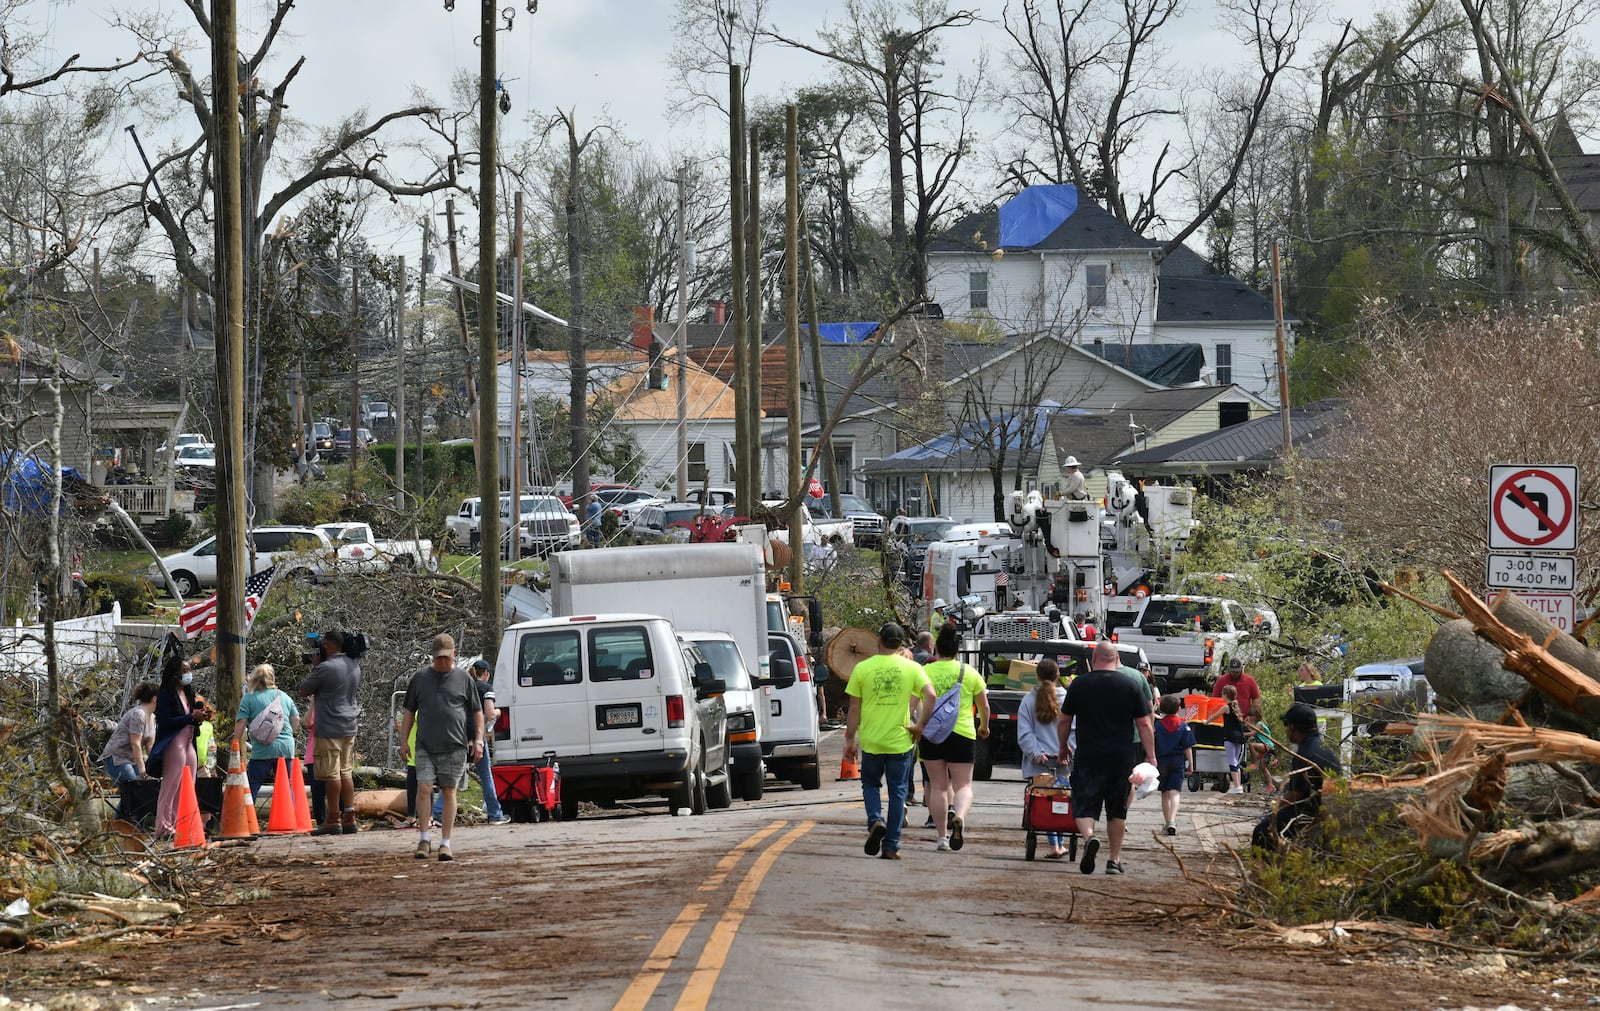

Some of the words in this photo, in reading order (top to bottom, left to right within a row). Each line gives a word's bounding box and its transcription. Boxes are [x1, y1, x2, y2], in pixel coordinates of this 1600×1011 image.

[1506, 560, 1534, 571] 3:00
[1540, 562, 1557, 571] PM
[1495, 572, 1509, 582] TO
[1516, 574, 1543, 584] 4:00
[1550, 575, 1567, 585] PM
[1526, 599, 1562, 613] CTLY
